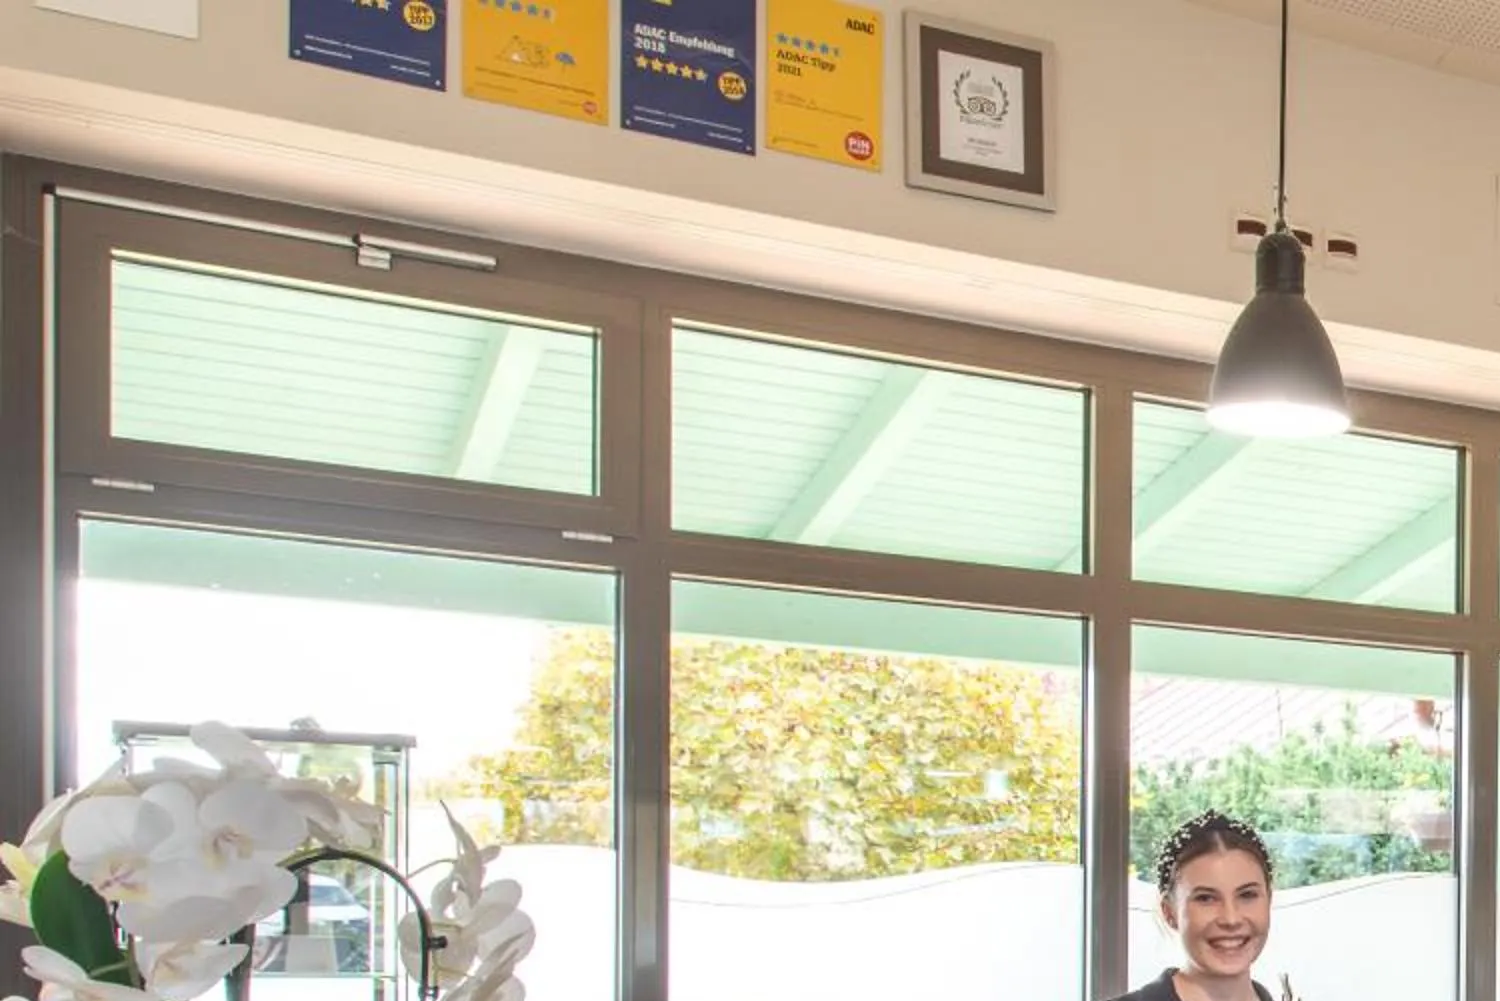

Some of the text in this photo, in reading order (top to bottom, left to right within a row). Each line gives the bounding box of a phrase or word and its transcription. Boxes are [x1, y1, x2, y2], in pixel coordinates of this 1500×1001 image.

[846, 18, 875, 35] ADAC
[634, 24, 735, 58] ADAC Empfehlung
[634, 37, 667, 53] 2018
[776, 49, 836, 73] ADAC Tipp
[777, 63, 802, 77] 2021
